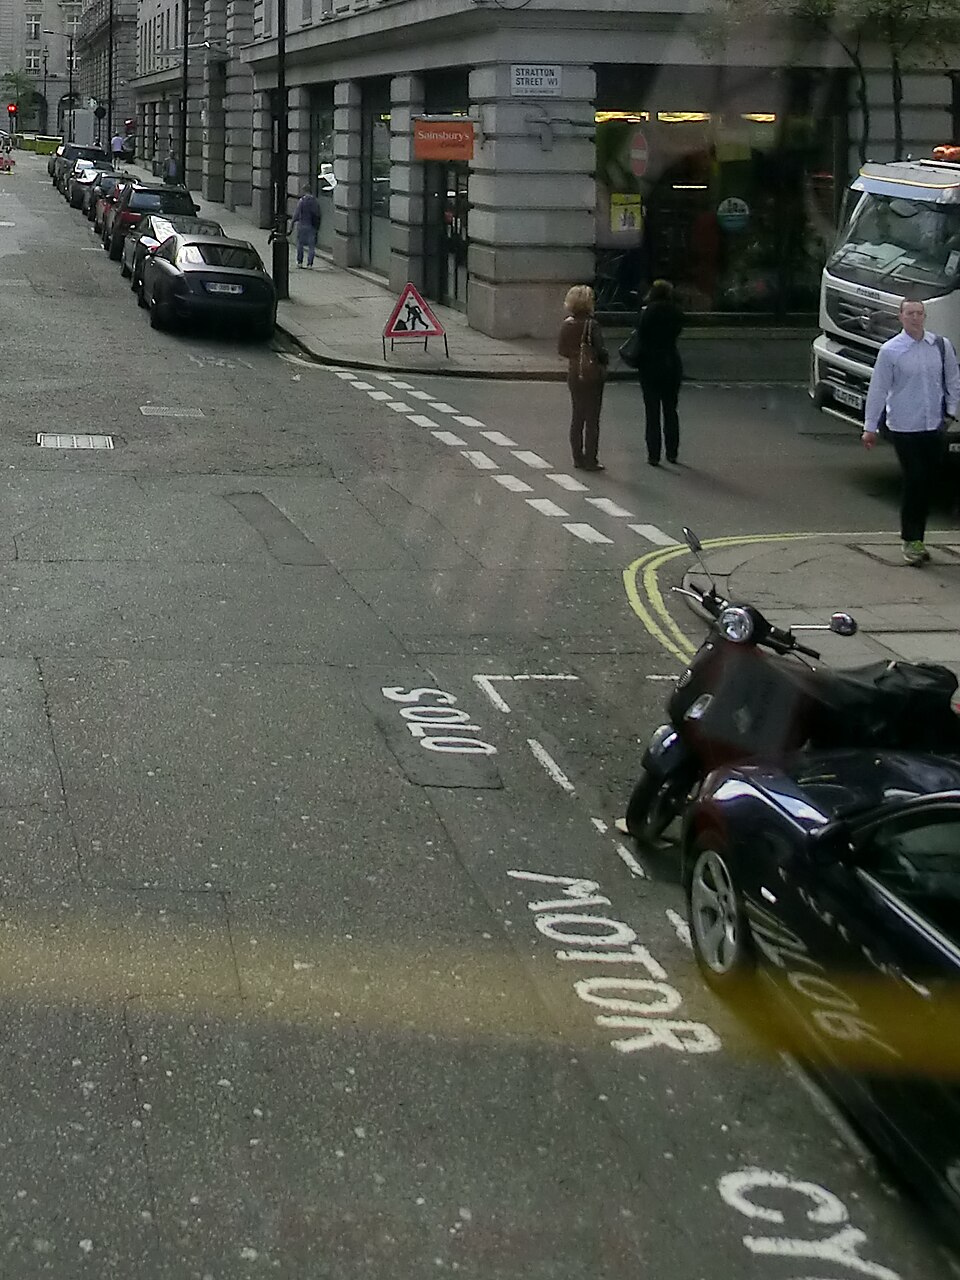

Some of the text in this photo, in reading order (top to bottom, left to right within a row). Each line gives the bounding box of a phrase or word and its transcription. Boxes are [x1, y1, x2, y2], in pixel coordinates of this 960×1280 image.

[515, 68, 555, 77] STRATTON
[515, 77, 558, 86] STREET W1
[418, 130, 470, 142] Sainsbury's
[381, 686, 498, 756] SOLO
[506, 869, 723, 1054] MOTOR
